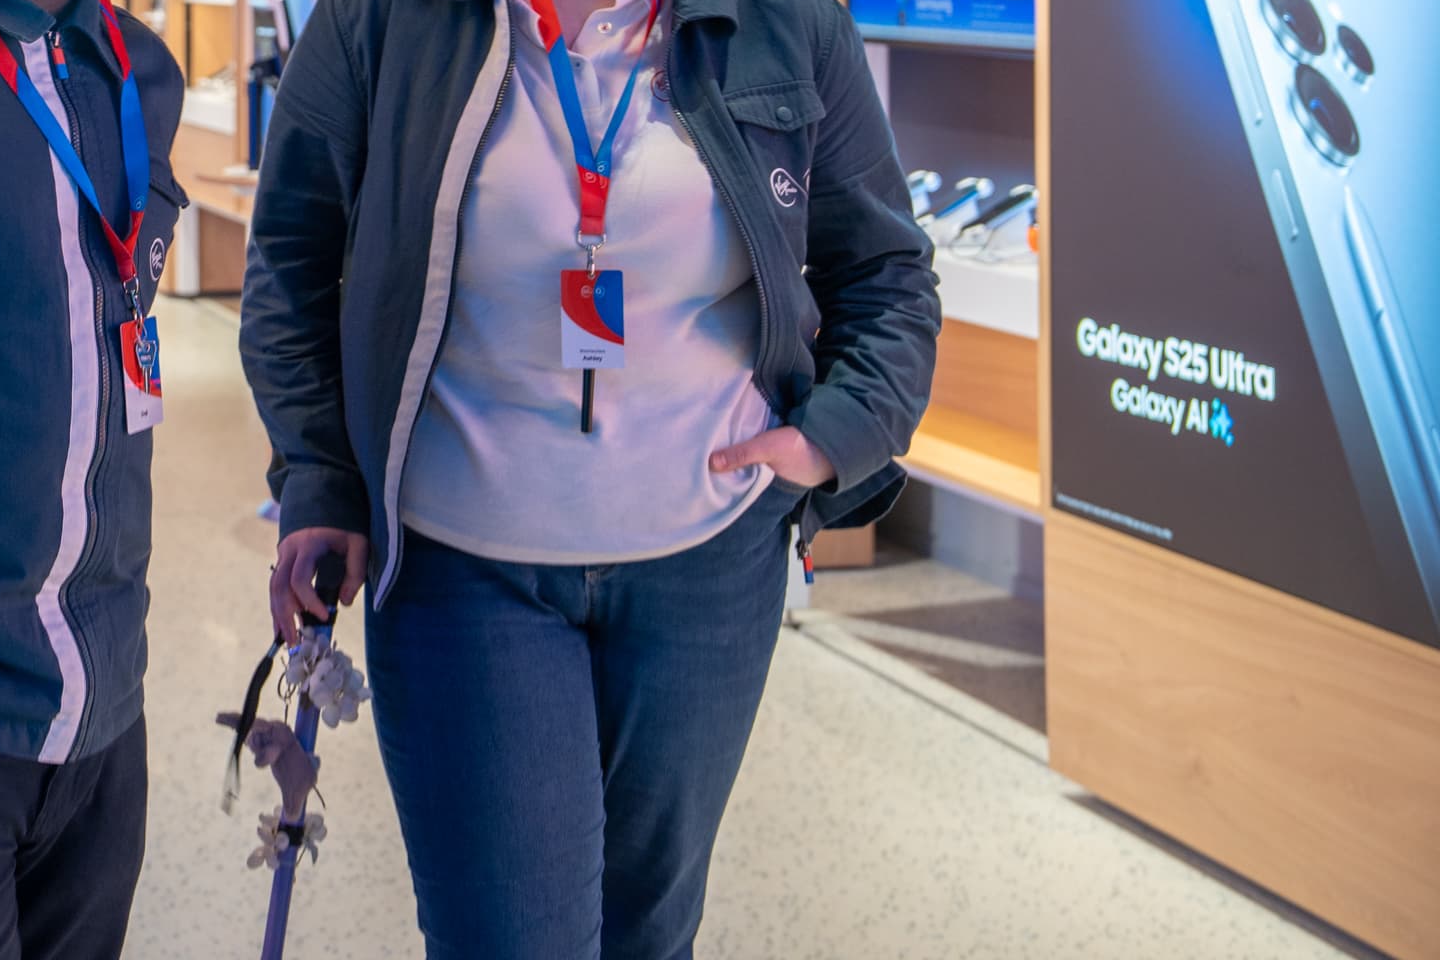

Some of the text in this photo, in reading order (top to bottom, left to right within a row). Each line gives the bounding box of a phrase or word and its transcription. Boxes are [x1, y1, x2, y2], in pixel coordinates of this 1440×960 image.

[1076, 317, 1275, 401] Galaxy S25 Ultra
[1110, 378, 1209, 436] Galaxy AI
